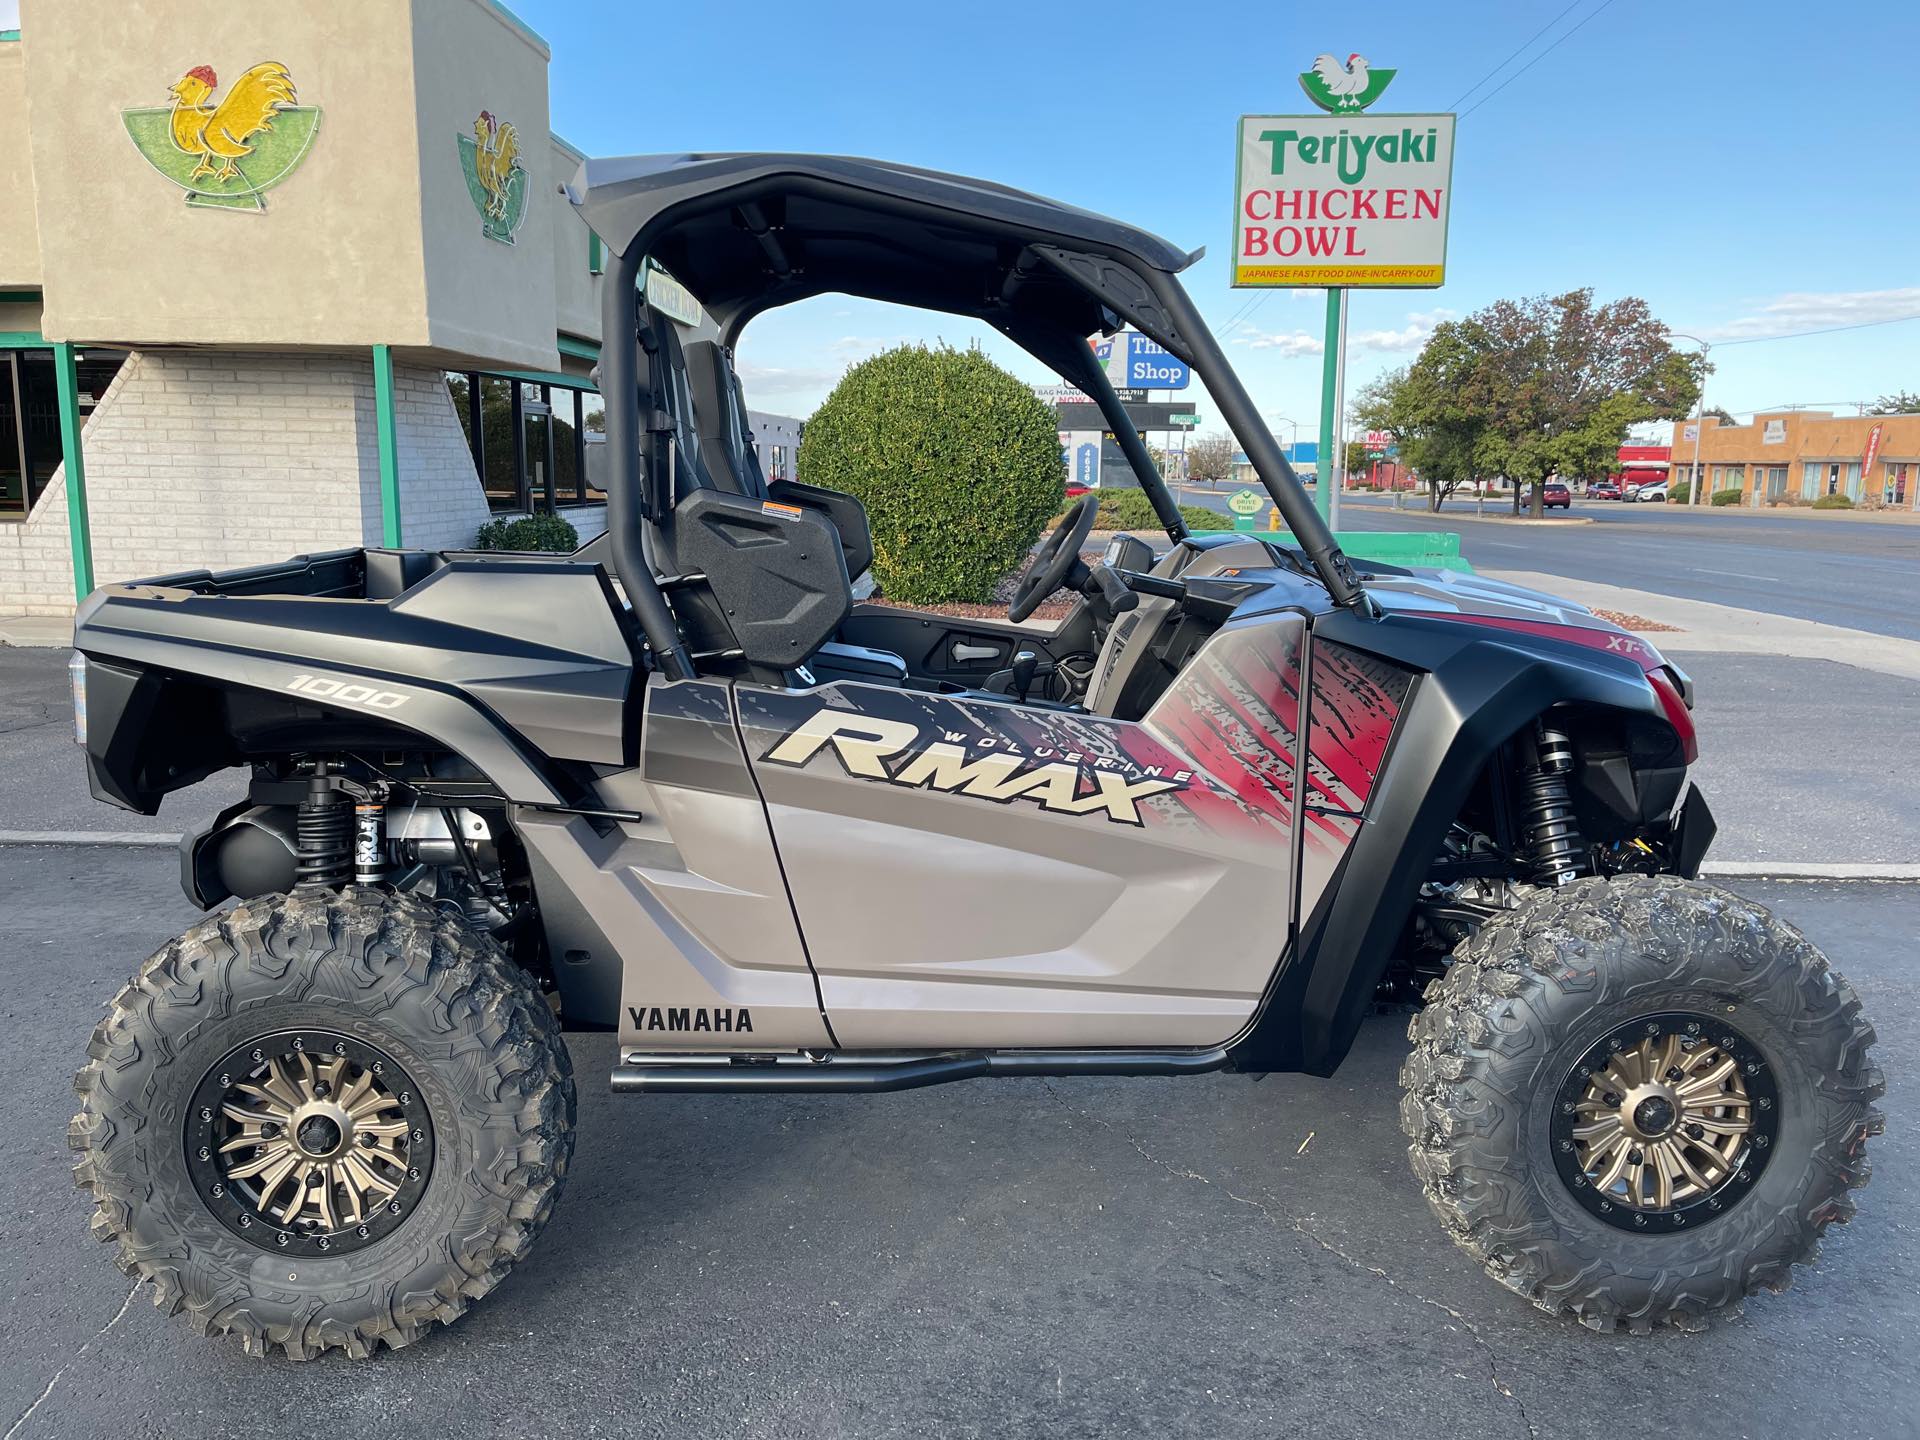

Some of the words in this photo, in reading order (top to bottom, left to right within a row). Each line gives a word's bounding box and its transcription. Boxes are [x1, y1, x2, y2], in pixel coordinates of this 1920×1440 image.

[1258, 128, 1437, 185] Teriyaki
[1244, 189, 1442, 221] CHICKEN
[1243, 226, 1367, 257] BOWL
[1243, 269, 1290, 278] JAPANESE
[1292, 269, 1316, 278] FAST
[1318, 269, 1344, 278] FOOD
[1133, 362, 1182, 384] Shop
[286, 674, 412, 709] 1000
[765, 709, 1181, 824] RMAX
[943, 730, 1196, 783] WOLVERINE
[628, 1007, 754, 1033] YAMAHA
